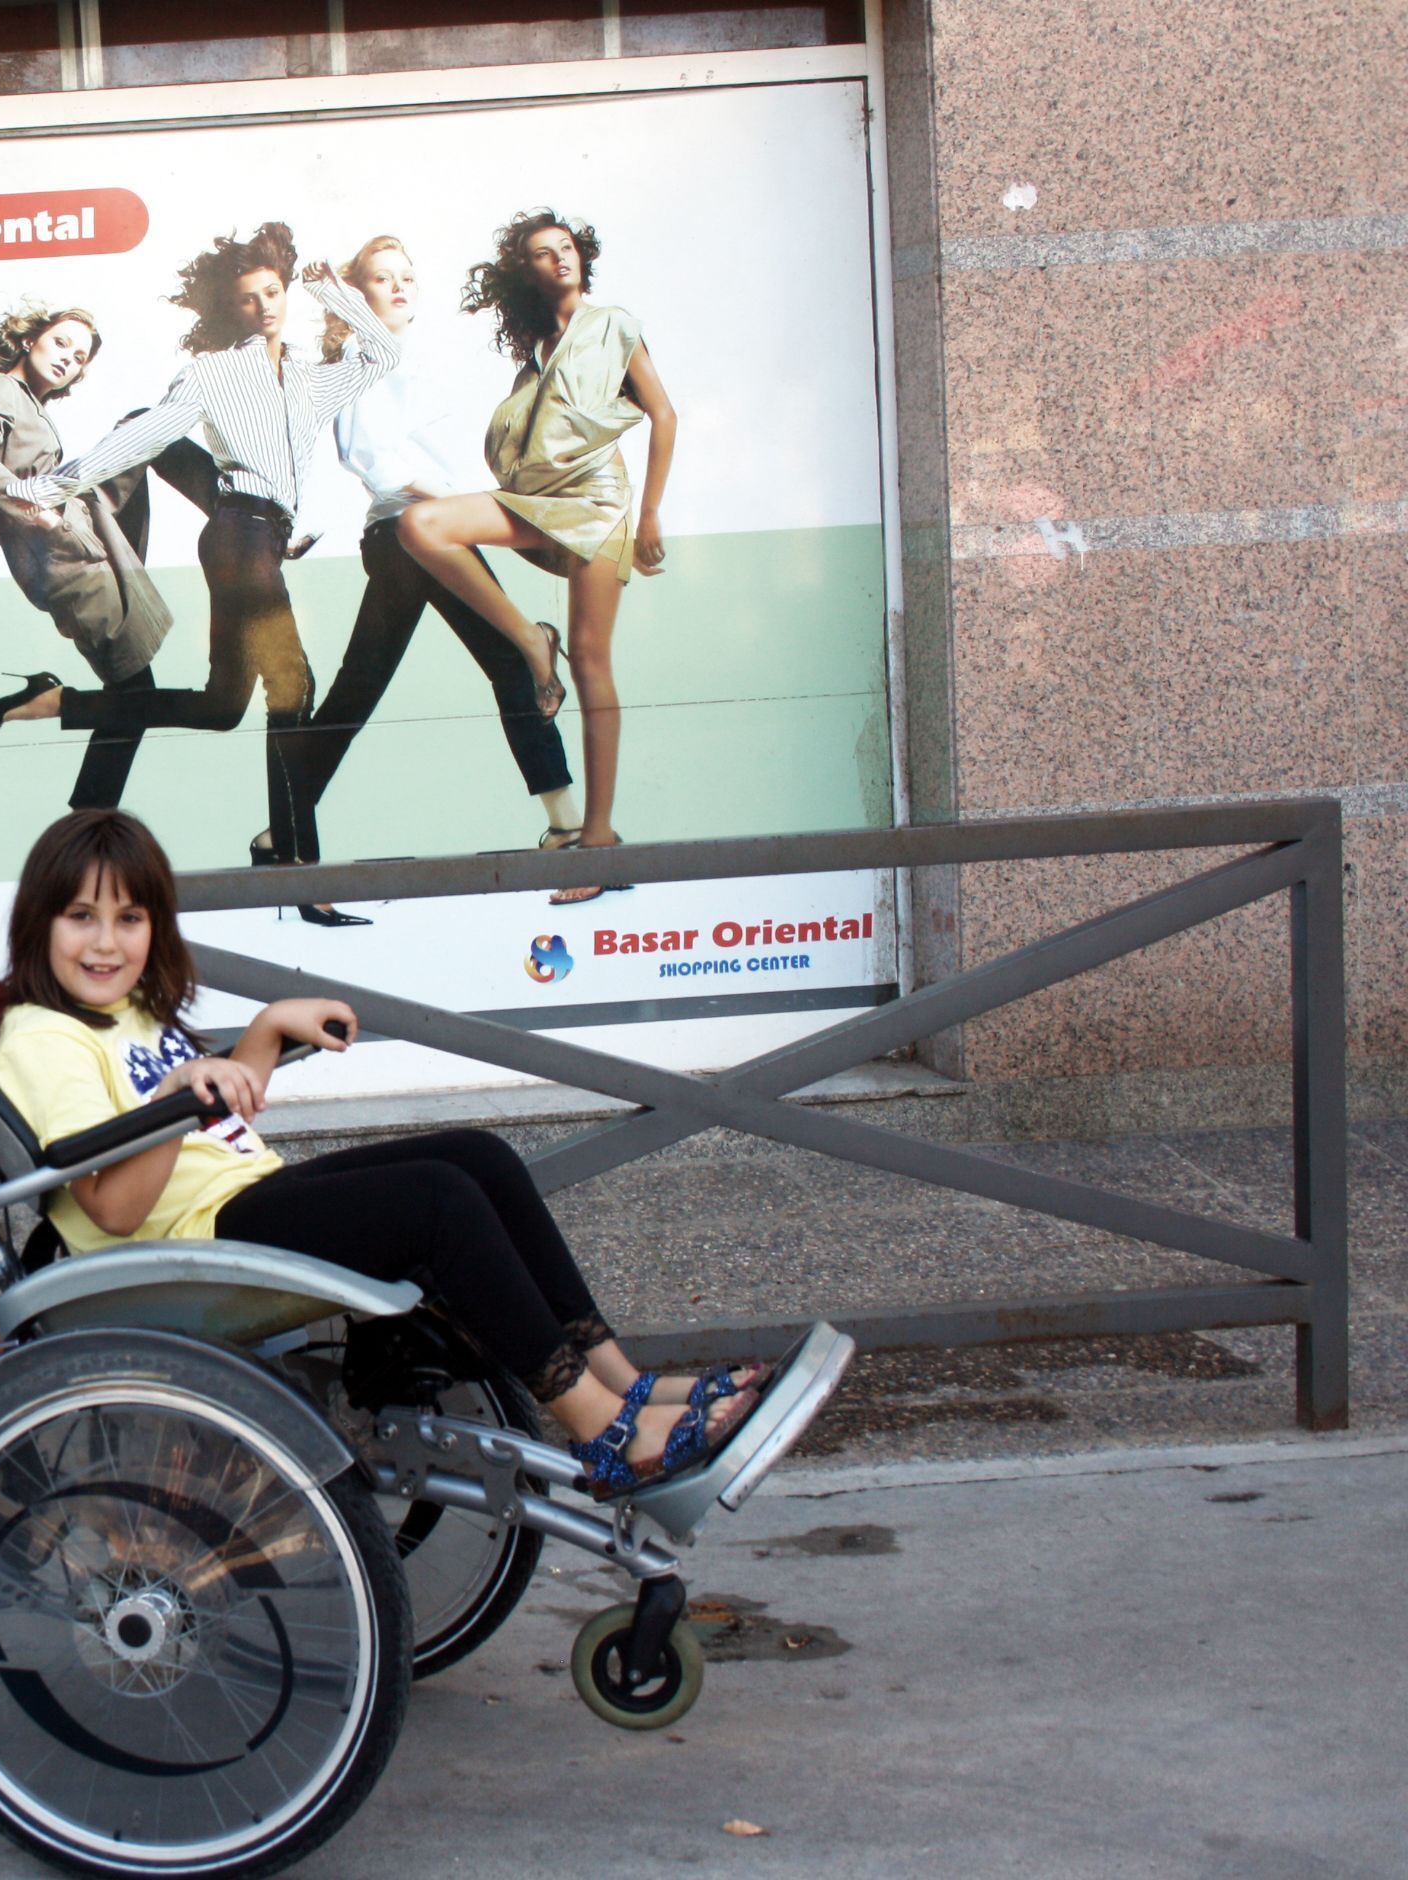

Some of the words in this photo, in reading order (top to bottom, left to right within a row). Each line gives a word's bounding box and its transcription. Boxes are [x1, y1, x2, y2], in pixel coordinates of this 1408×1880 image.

[593, 929, 699, 956] Basar
[712, 913, 873, 948] Oriental
[659, 958, 742, 978] SHOPPING
[747, 954, 811, 973] CENTER
